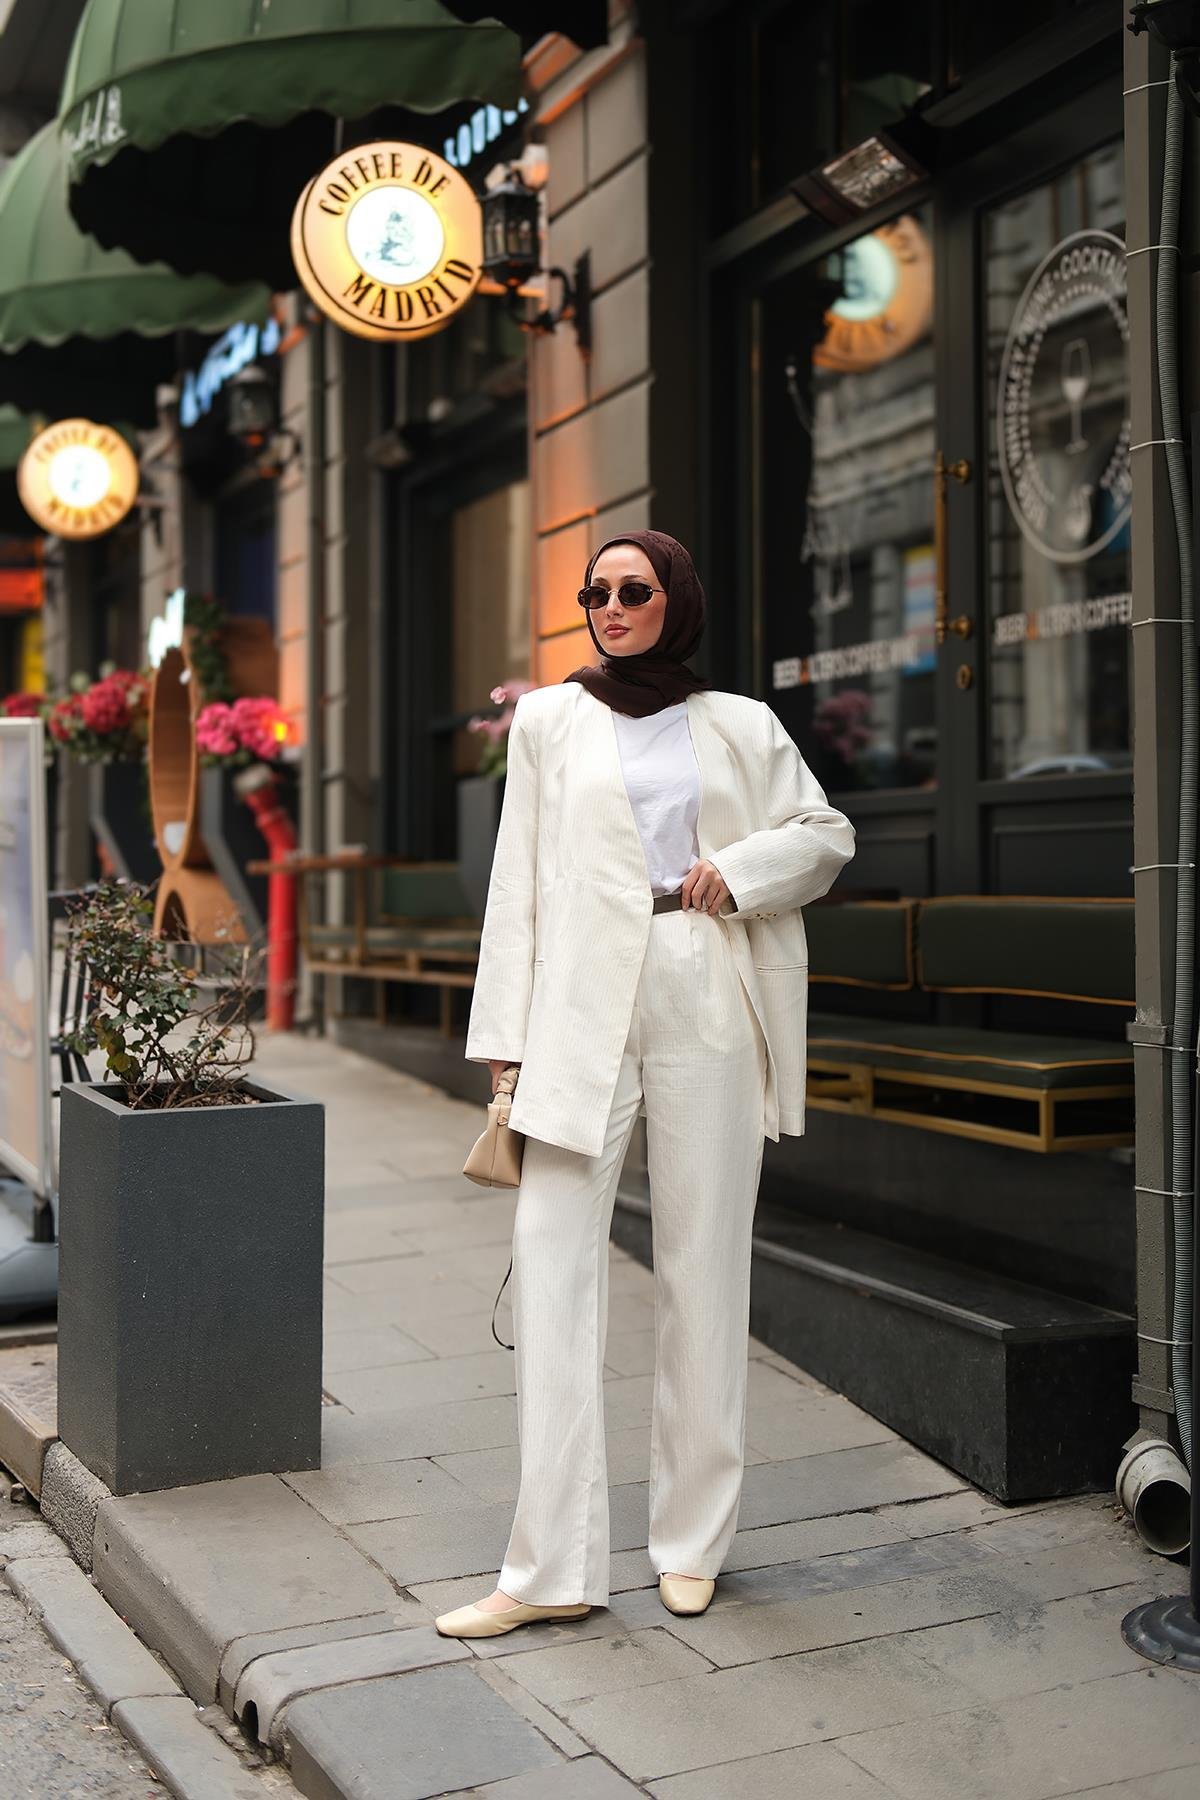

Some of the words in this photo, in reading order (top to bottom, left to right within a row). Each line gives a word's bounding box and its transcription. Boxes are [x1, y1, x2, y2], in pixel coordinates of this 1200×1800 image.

[318, 152, 402, 217] COFFEE
[411, 157, 452, 199] DE
[342, 258, 476, 323] MADRID
